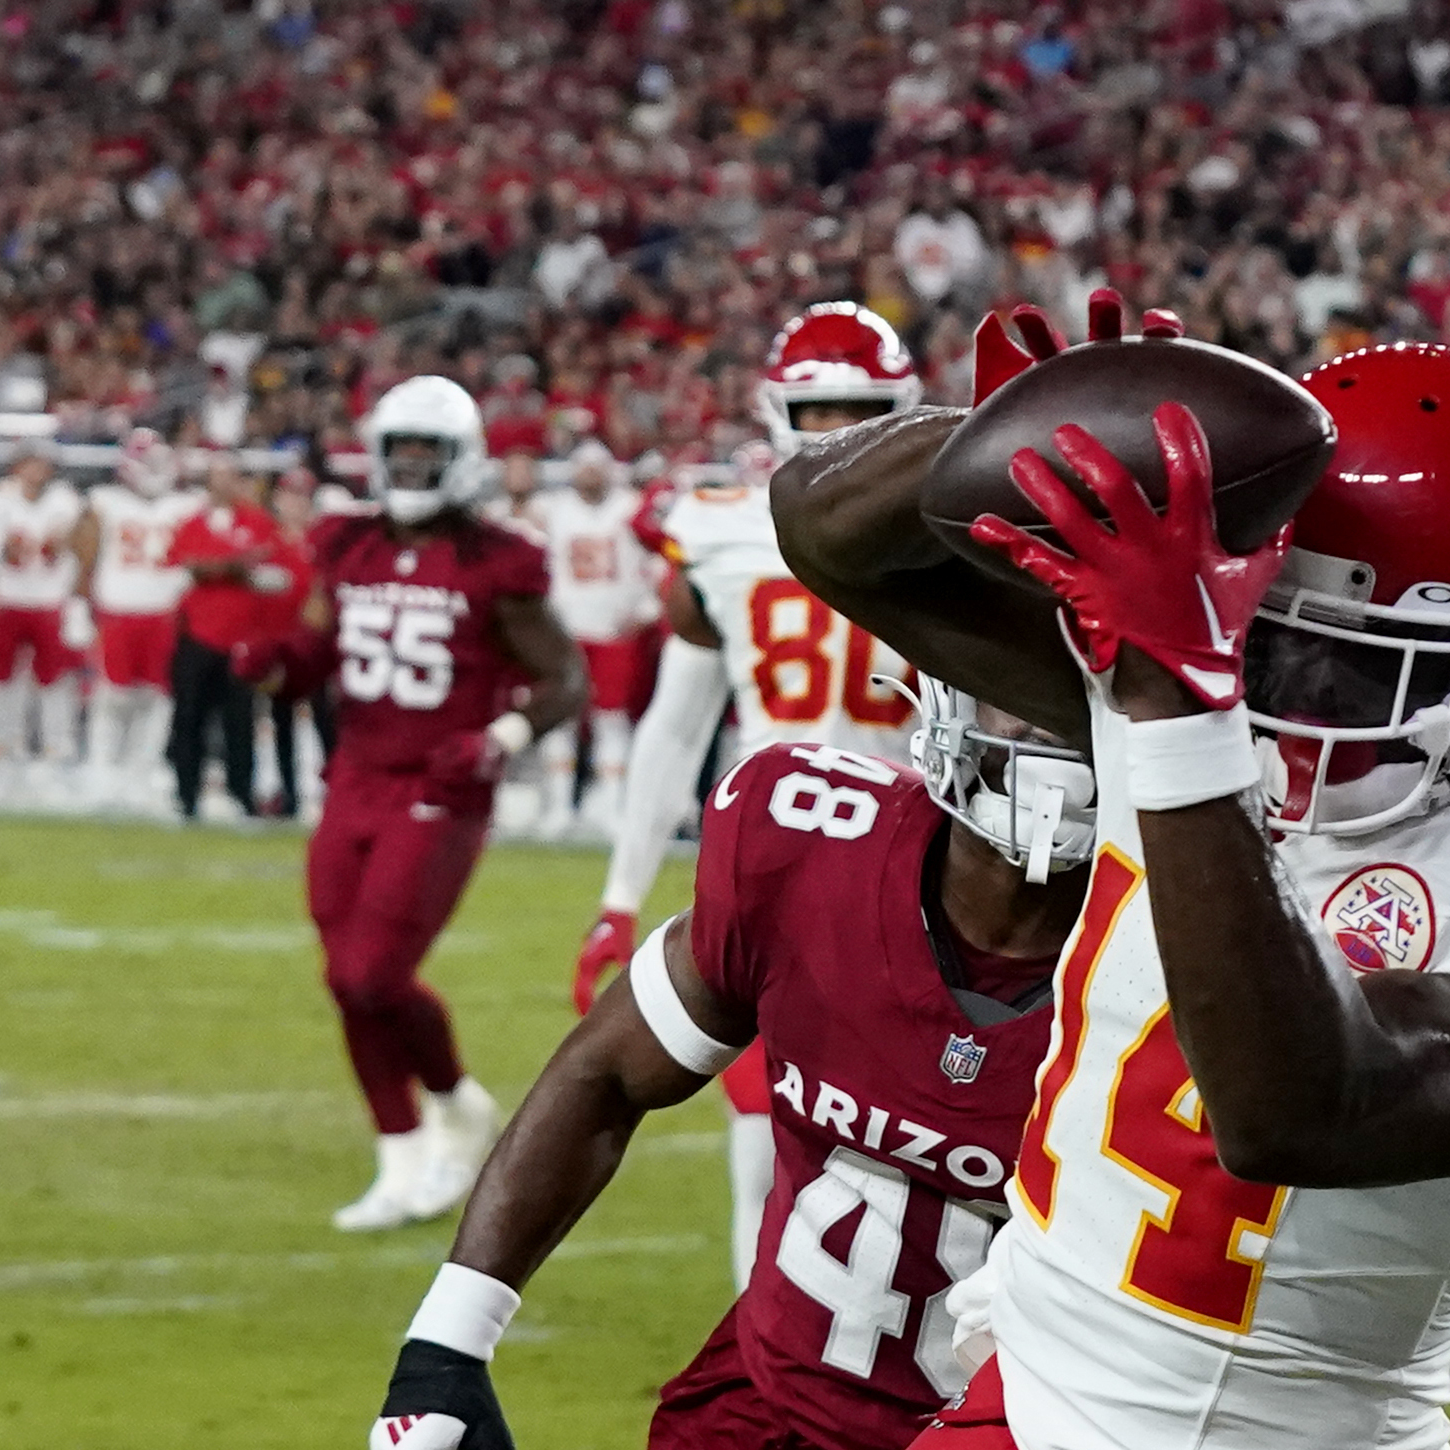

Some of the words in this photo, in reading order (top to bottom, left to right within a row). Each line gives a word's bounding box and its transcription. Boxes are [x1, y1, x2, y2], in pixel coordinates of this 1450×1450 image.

[338, 602, 455, 711] 55
[768, 745, 899, 841] 48
[947, 1052, 974, 1076] NFL
[1016, 841, 1288, 1335] 14
[773, 1061, 1018, 1189] ARIZO
